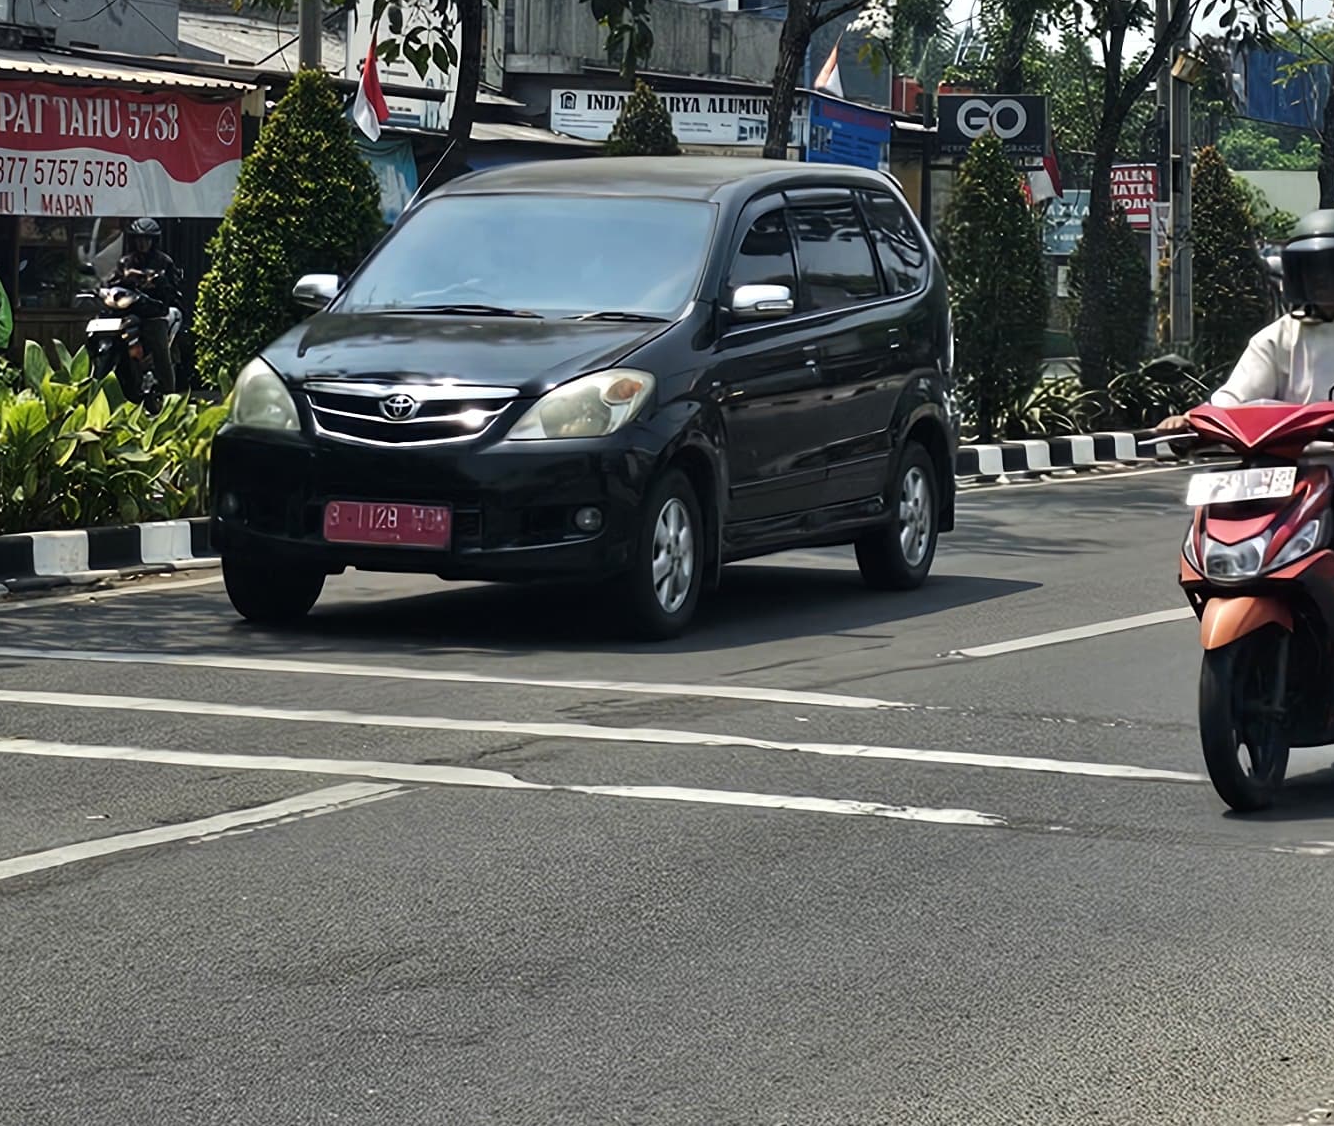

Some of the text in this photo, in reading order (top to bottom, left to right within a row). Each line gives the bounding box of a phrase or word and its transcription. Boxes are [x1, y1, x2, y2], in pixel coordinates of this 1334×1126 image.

[53, 96, 121, 139] TAHU
[127, 103, 179, 141] 5758
[956, 99, 1027, 139] GO
[34, 159, 78, 186] 5757
[83, 161, 128, 188] 5758
